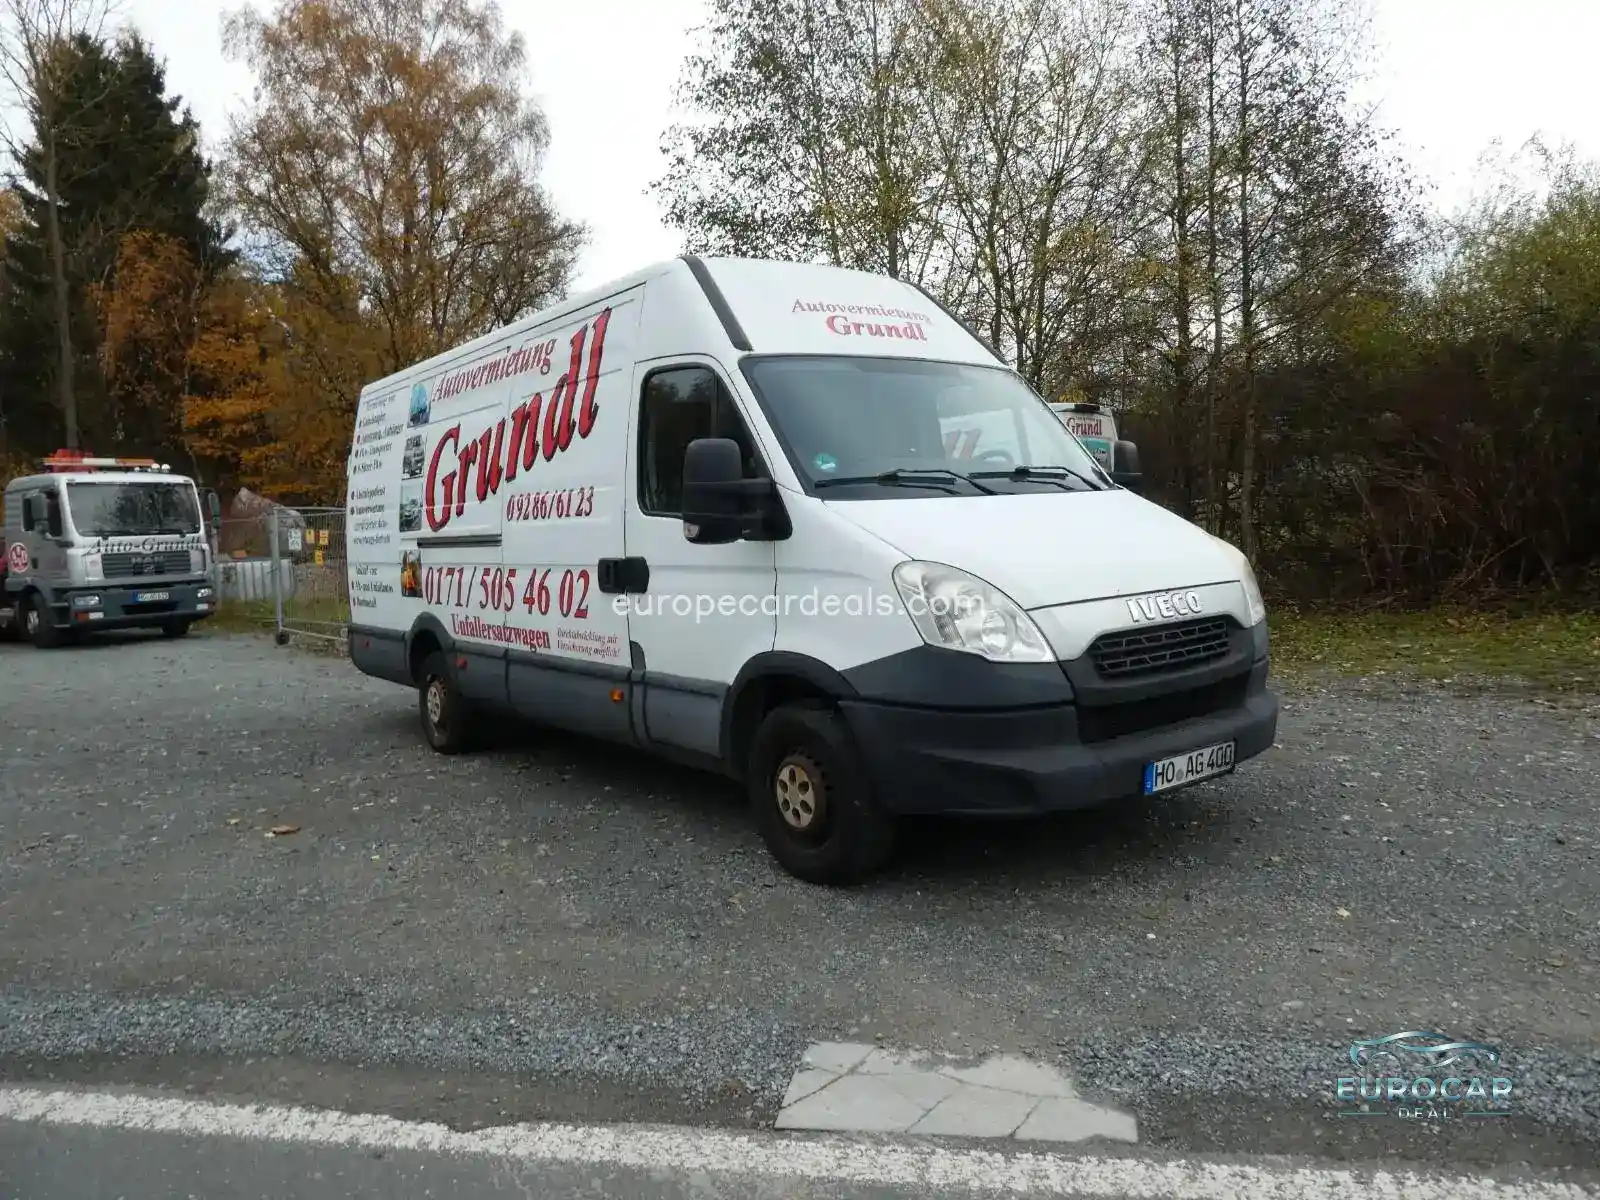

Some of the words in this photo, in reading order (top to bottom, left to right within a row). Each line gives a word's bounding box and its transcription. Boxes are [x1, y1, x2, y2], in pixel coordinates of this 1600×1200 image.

[826, 315, 927, 341] Grundl
[431, 338, 557, 402] Autovermietung
[425, 306, 612, 532] Grundl
[1066, 417, 1102, 435] Grundl
[523, 567, 551, 616] 46
[559, 568, 590, 619] 02
[1126, 590, 1203, 623] IVECO
[450, 613, 551, 652] Unfallersatzwagen
[1154, 763, 1176, 787] HO
[1185, 752, 1204, 777] AG
[1207, 744, 1234, 771] 400
